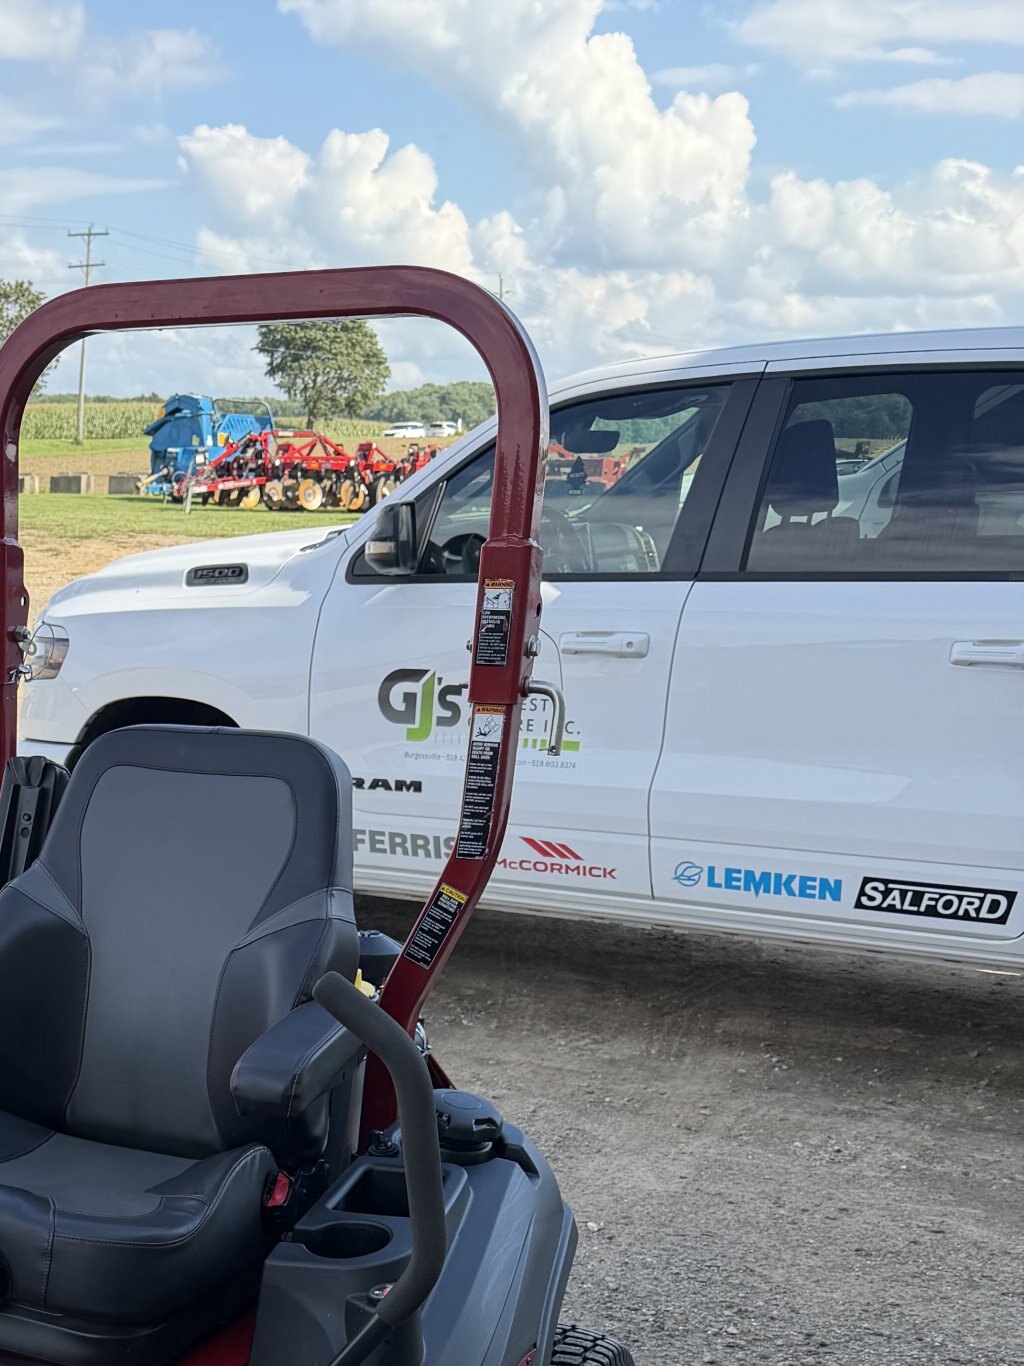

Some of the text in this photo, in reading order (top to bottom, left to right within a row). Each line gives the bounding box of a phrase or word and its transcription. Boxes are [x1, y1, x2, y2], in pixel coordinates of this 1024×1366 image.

[193, 568, 240, 578] 1500
[404, 751, 441, 761] Burgessville
[707, 865, 843, 902] LEMKEN
[445, 888, 465, 901] CAUTION
[860, 881, 1007, 920] SALFORD
